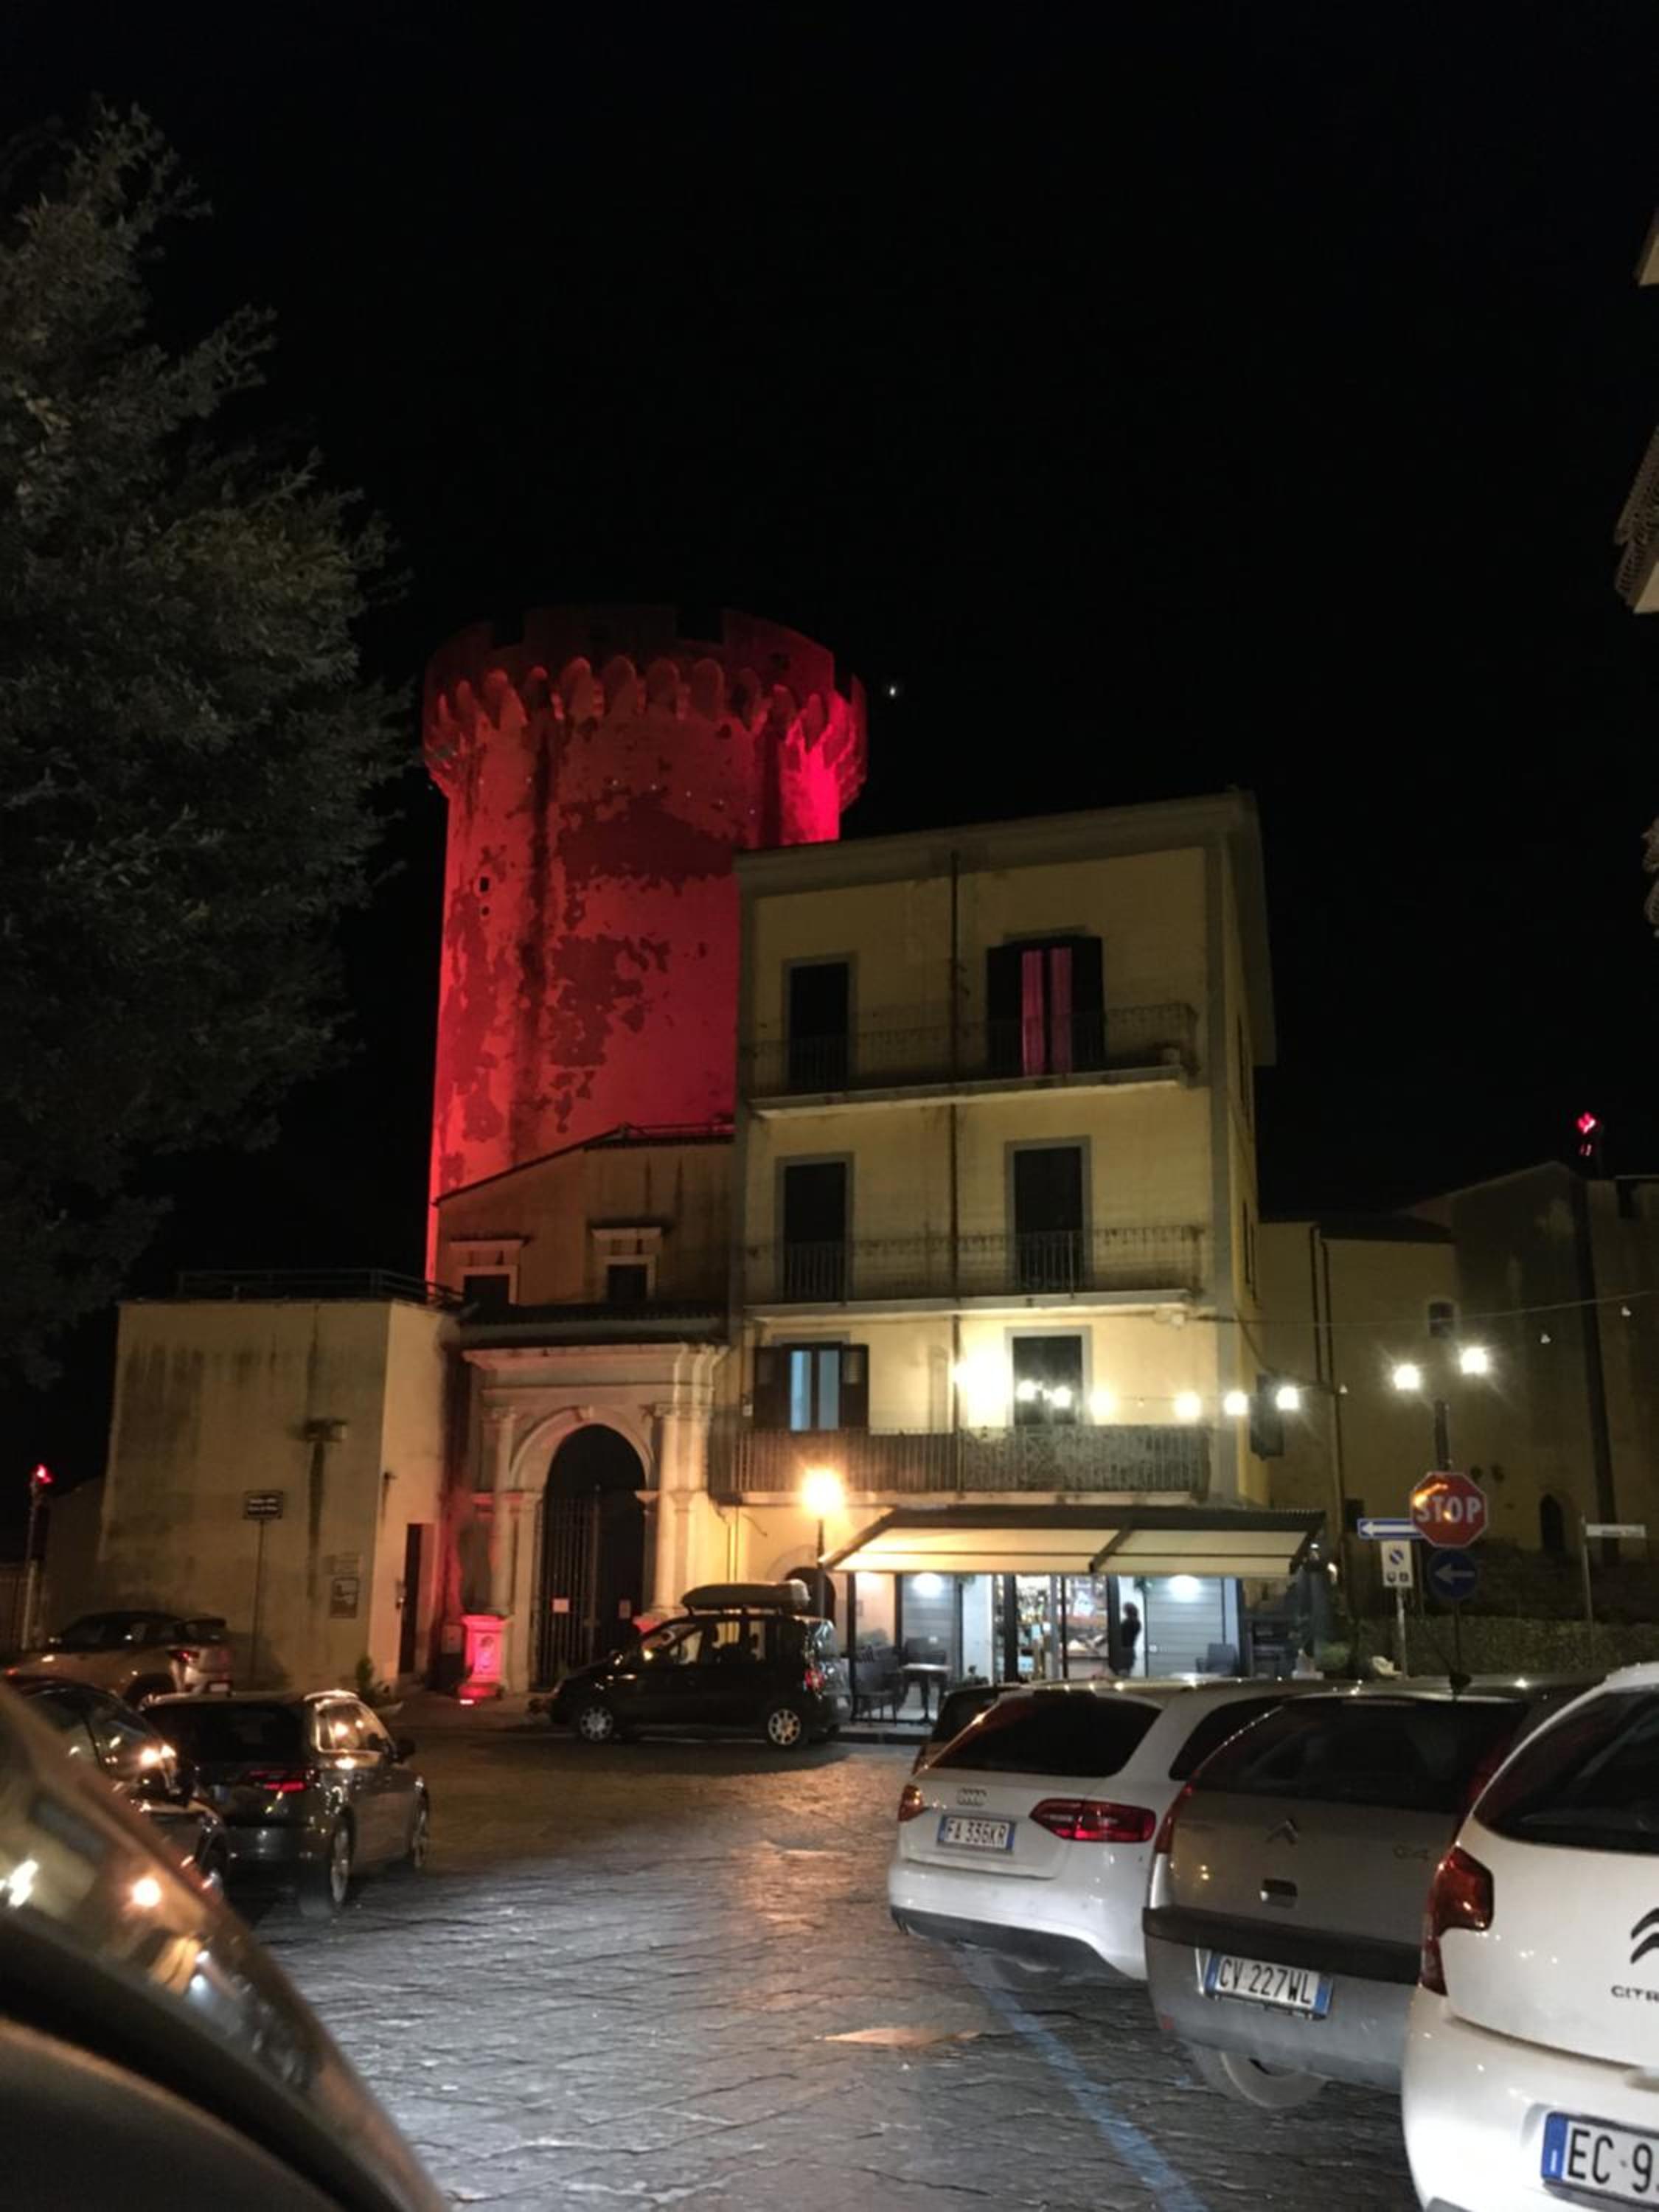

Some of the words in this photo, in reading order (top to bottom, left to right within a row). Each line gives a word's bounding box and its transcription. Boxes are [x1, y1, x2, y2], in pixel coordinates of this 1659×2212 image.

[1415, 1495, 1482, 1524] STOP
[1219, 1958, 1244, 1990] CV
[1248, 1964, 1312, 2005] 227WL
[1568, 2128, 1615, 2185] EC
[1632, 2143, 1659, 2194] 9
